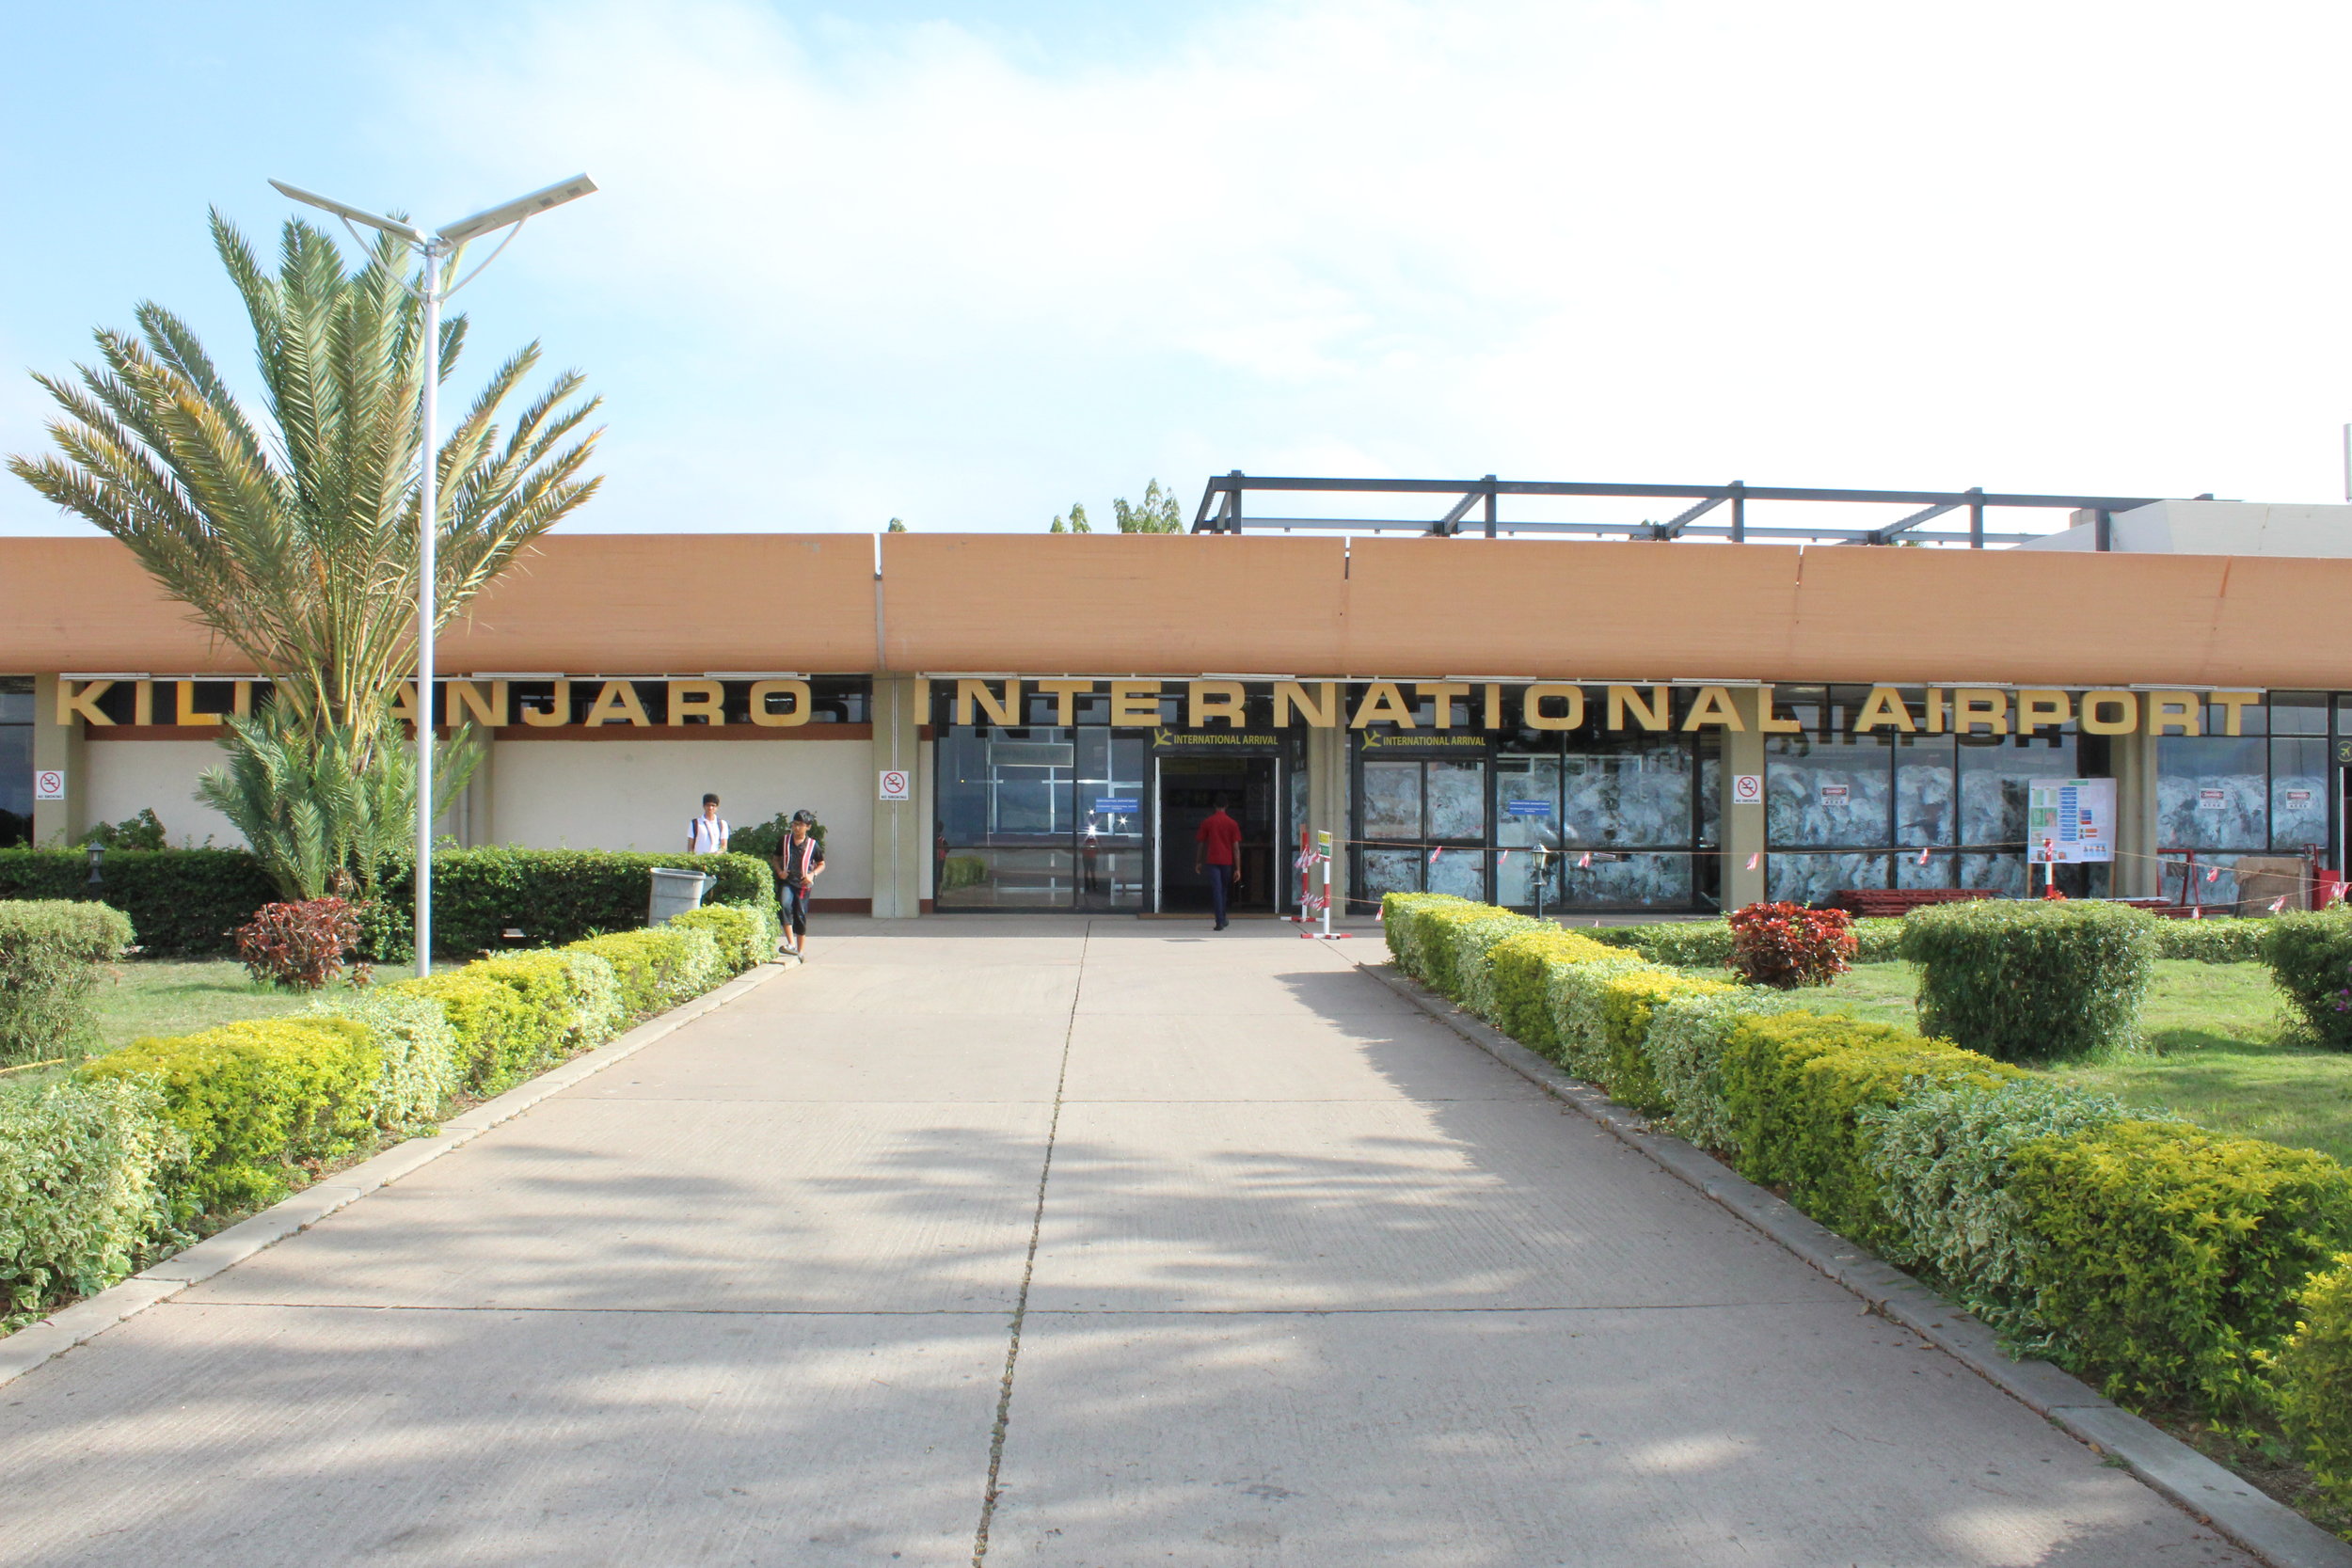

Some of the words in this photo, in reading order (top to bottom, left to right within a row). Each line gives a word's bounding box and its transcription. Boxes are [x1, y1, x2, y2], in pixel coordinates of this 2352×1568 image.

[56, 679, 812, 728] KILIANJARO
[914, 679, 1801, 733] INTERNATIONAL
[1852, 687, 2260, 736] AIRPORT
[1173, 735, 1241, 745] INTERNATIONAL
[1242, 735, 1279, 745] ARRIVAL
[1383, 736, 1450, 746] INTERNATIONAL
[1451, 736, 1486, 746] ARRIVAL
